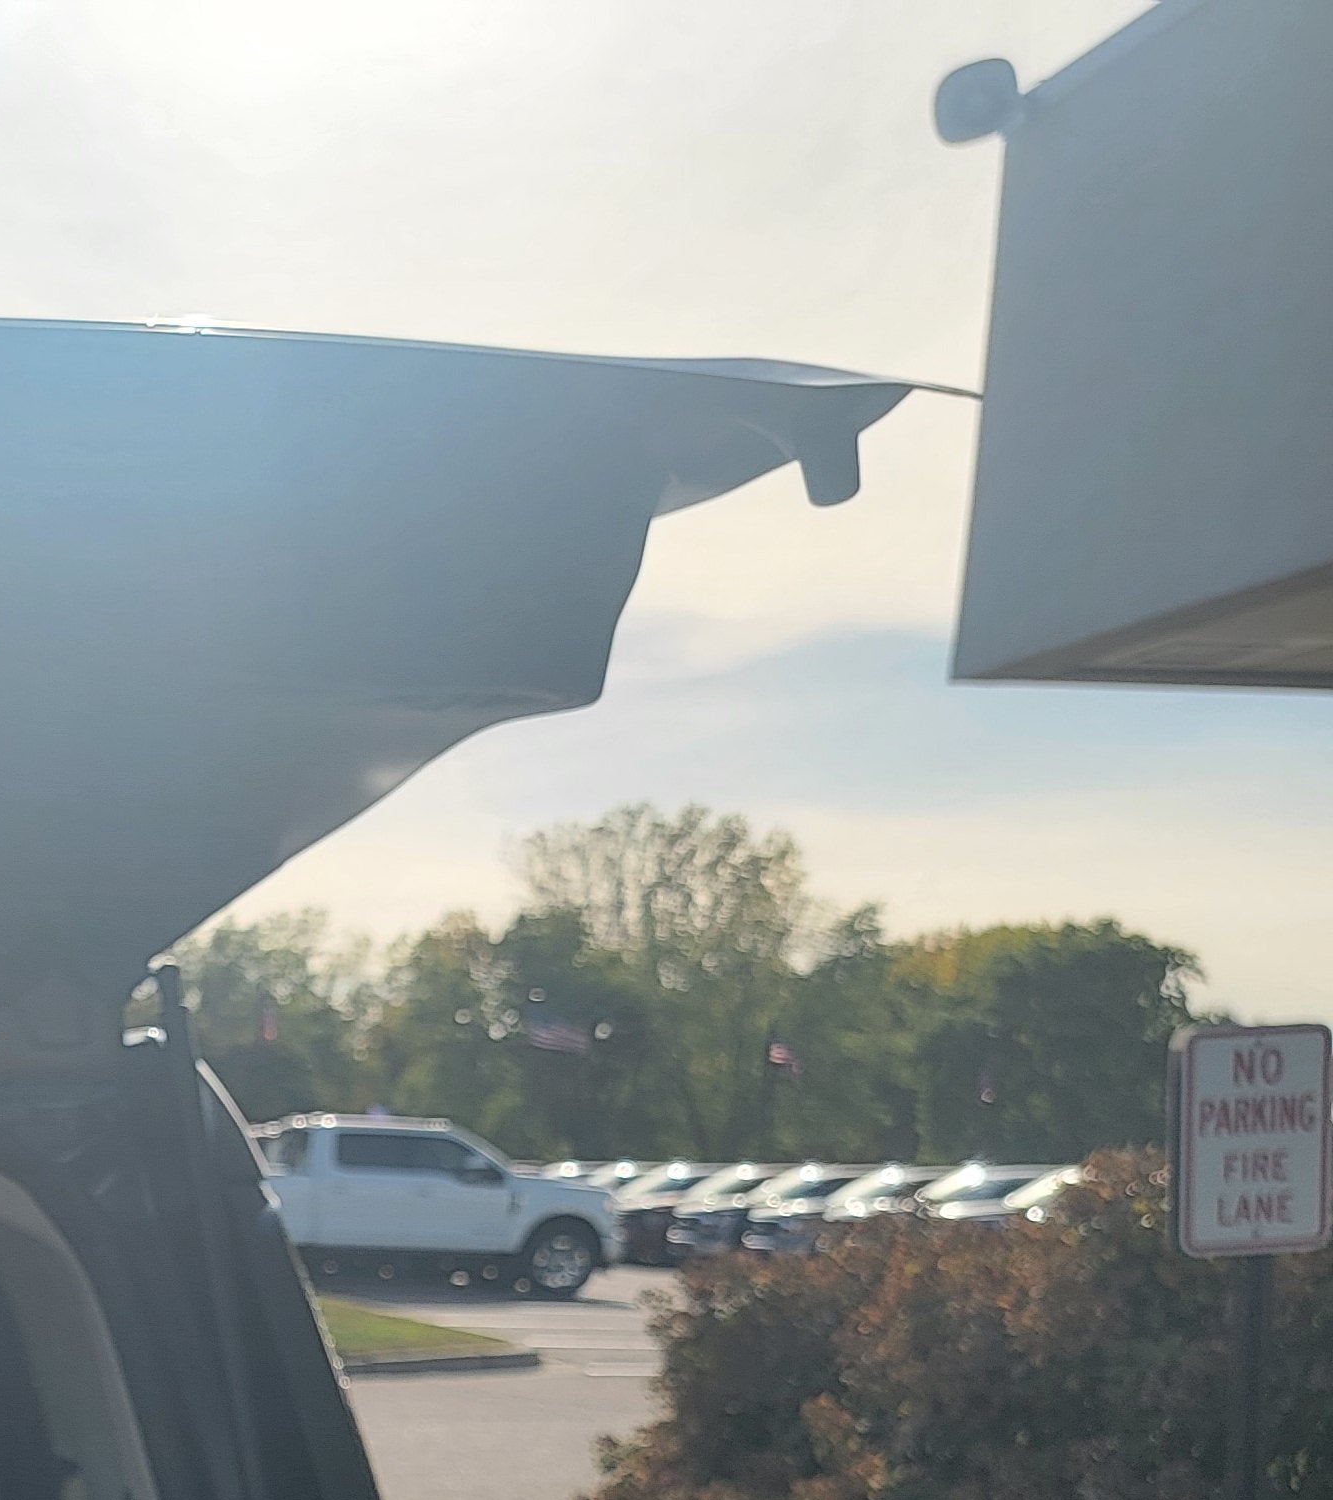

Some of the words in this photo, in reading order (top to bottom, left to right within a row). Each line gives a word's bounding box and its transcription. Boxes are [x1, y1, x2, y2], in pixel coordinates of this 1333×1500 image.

[1234, 1048, 1282, 1085] NO
[1198, 1094, 1316, 1137] PARKING
[1223, 1150, 1288, 1184] FIRE
[1216, 1193, 1294, 1229] LANE
